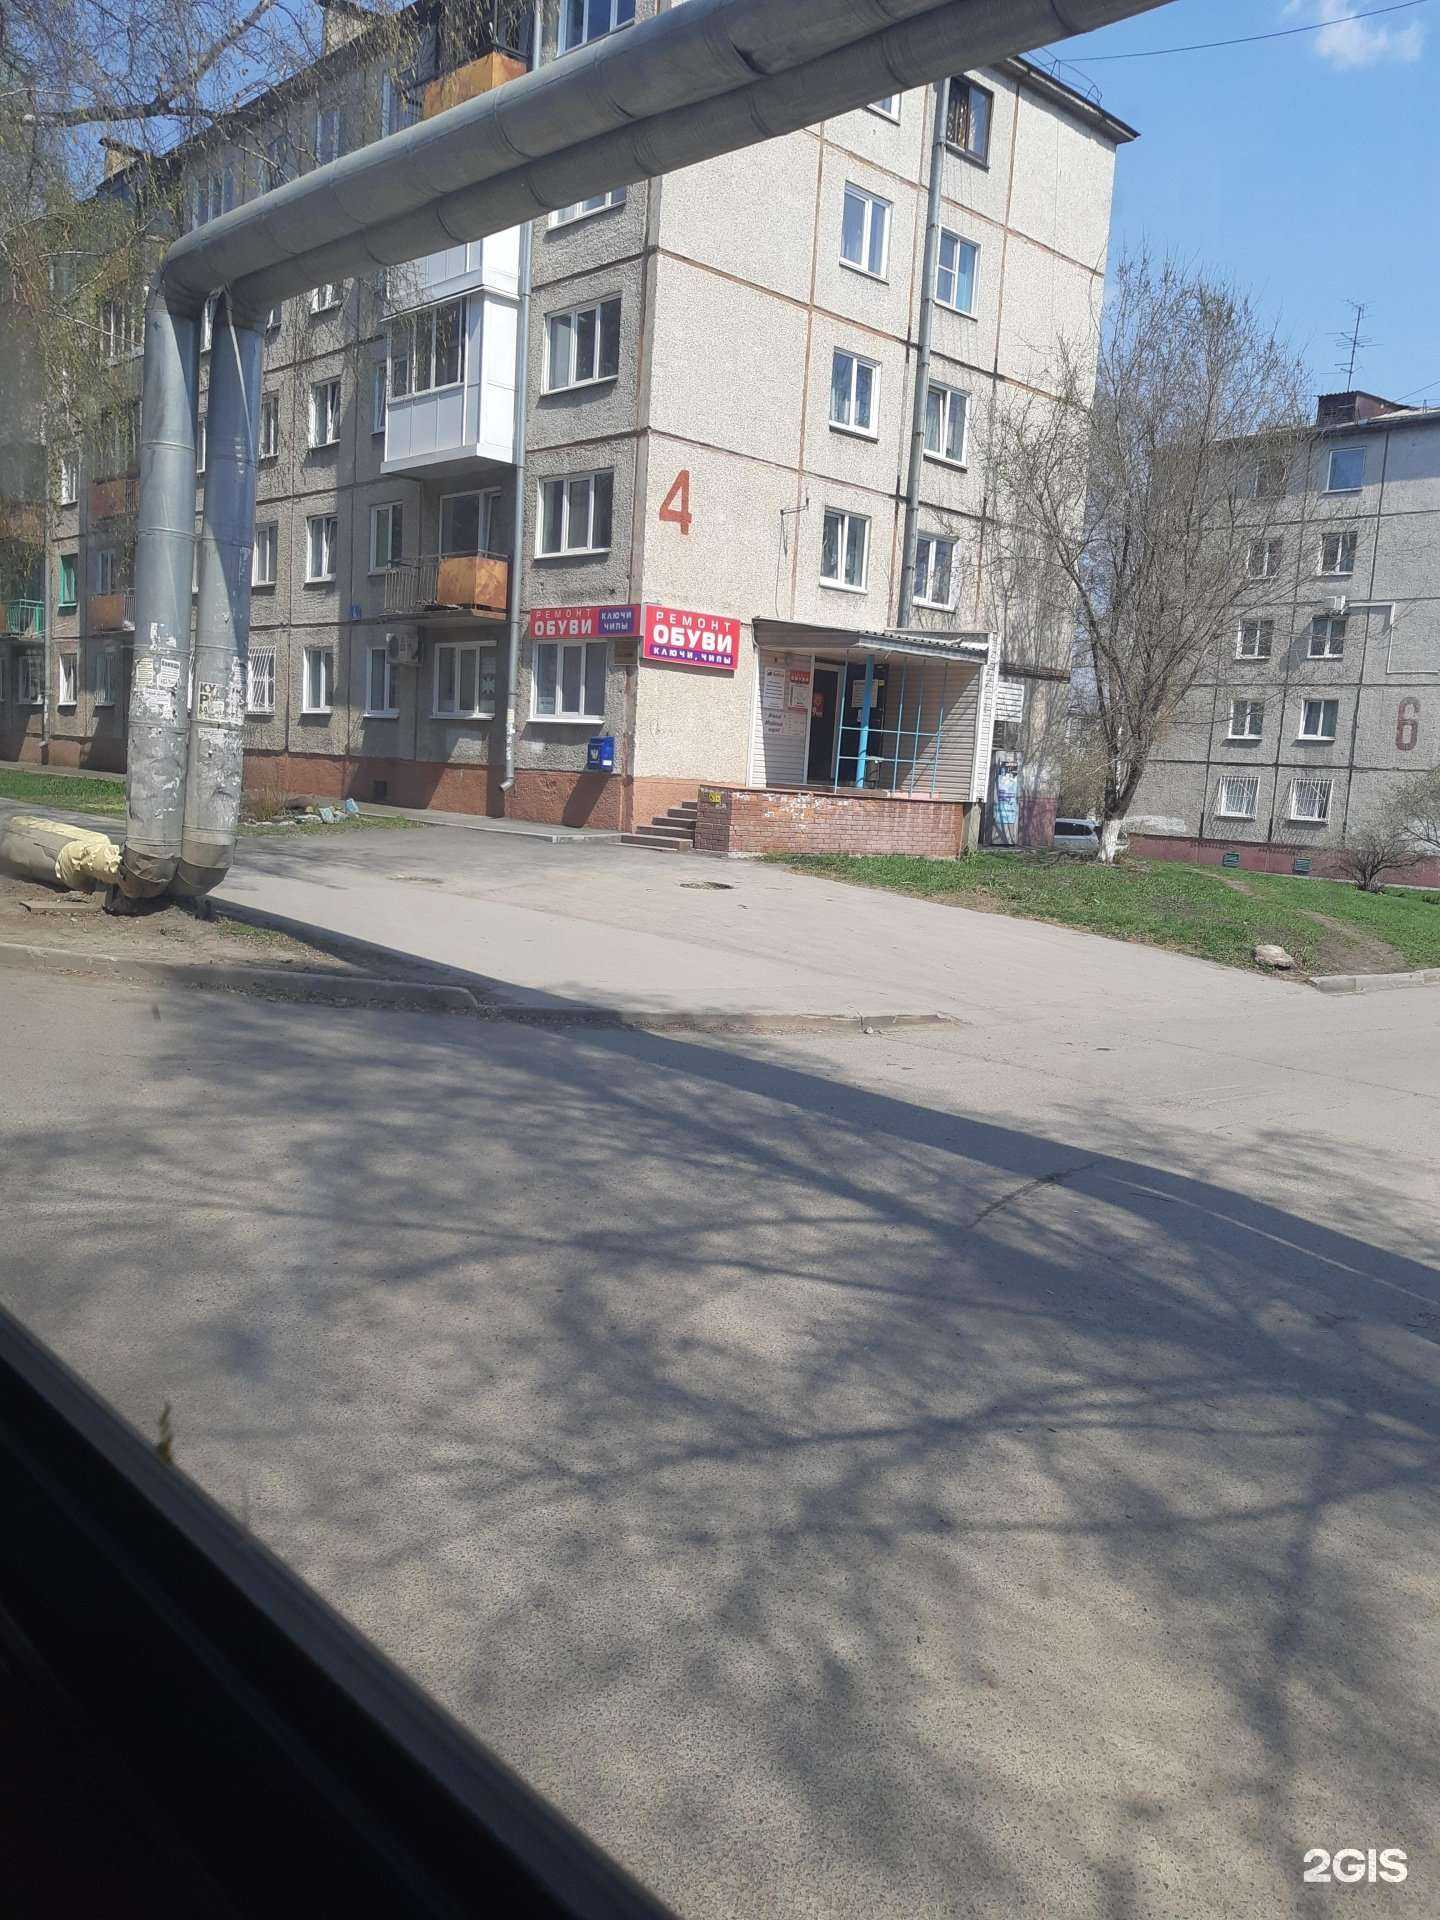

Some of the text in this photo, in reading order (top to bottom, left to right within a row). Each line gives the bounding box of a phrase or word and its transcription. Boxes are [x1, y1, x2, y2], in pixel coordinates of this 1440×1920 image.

[659, 470, 692, 535] 4
[536, 608, 592, 619] РЕМОНТ
[601, 611, 632, 620] КЛЮЧИ
[656, 611, 732, 632] РЕМОНТ
[534, 619, 593, 636] ОБУВИ
[603, 621, 628, 631] ЧИПЫ
[653, 624, 733, 654] ОБУВИ
[653, 647, 731, 665] КЛЮЧИ, ЧИПЫ
[1395, 697, 1420, 751] 6
